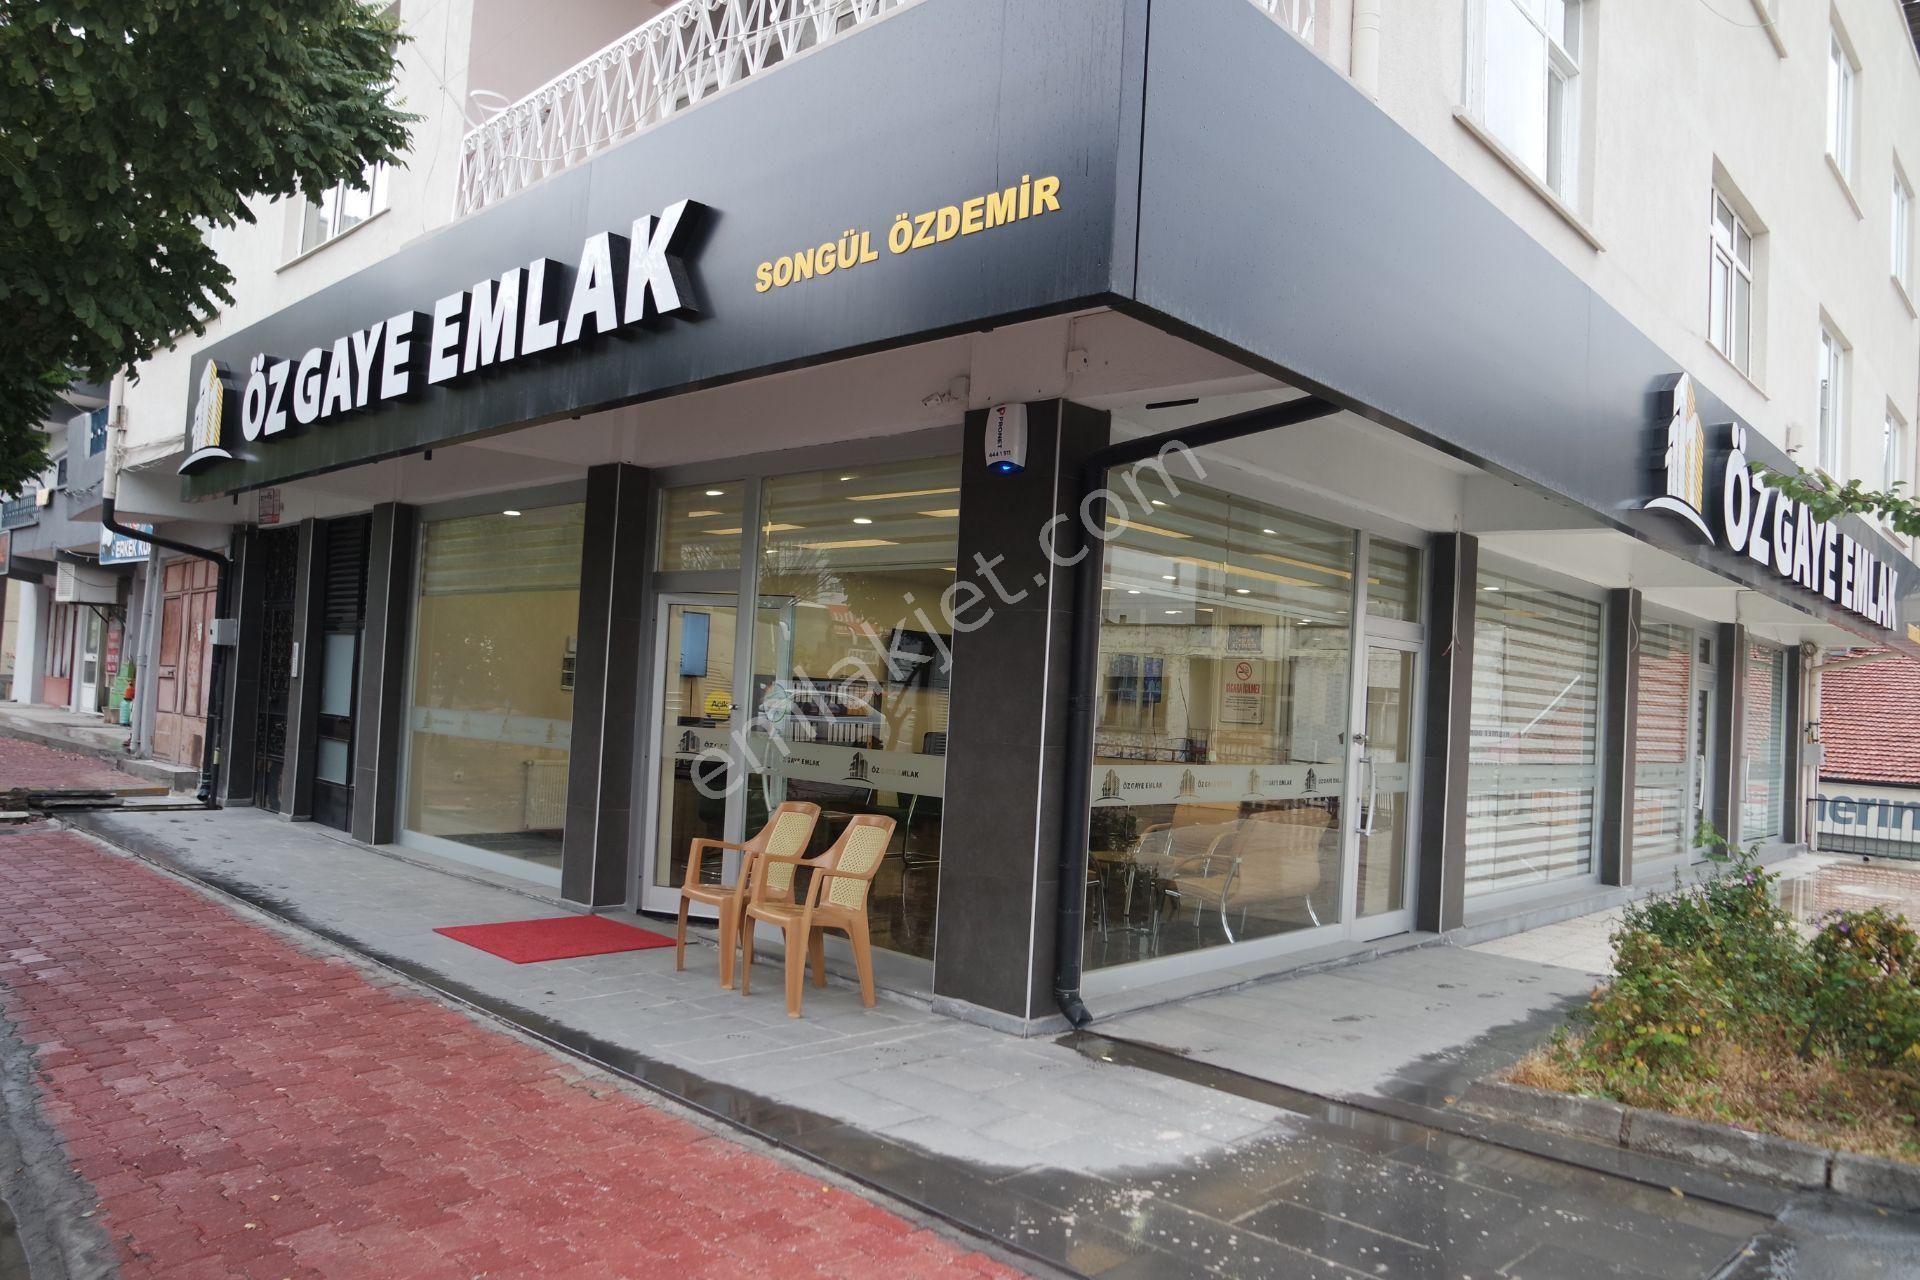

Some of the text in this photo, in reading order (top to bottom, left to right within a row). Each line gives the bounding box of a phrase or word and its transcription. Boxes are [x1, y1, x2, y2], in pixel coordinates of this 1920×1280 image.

[428, 199, 691, 386] EMLAK
[755, 174, 1061, 293] SONGÜL ÖZDEMİR
[1841, 533, 1898, 632] EMLAK
